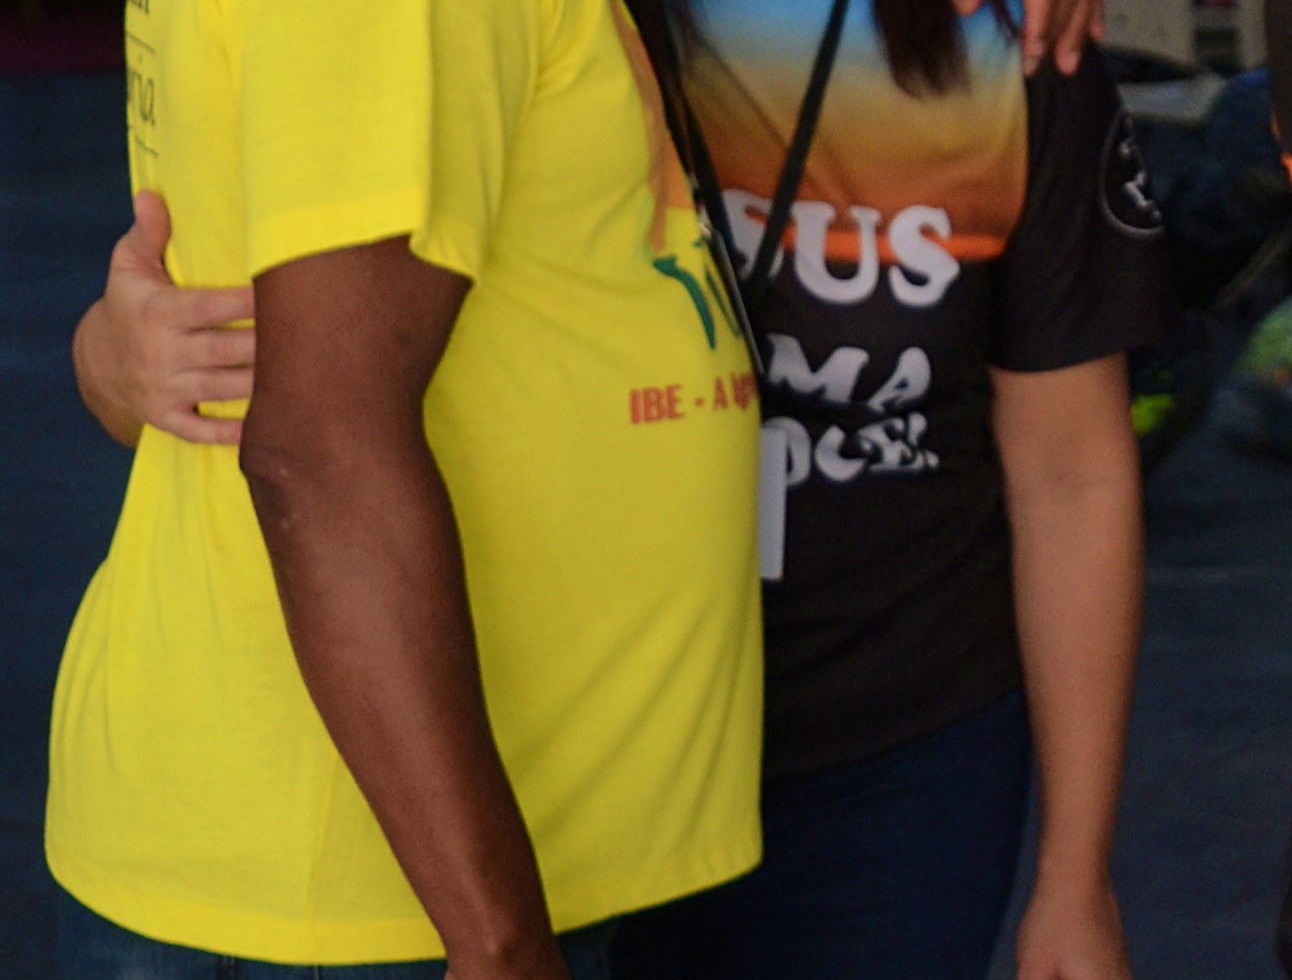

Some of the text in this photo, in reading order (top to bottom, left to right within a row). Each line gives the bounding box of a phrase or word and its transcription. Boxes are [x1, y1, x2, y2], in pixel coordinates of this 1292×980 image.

[722, 188, 960, 306] SUS
[630, 383, 685, 424] IBE
[765, 333, 932, 413] MA
